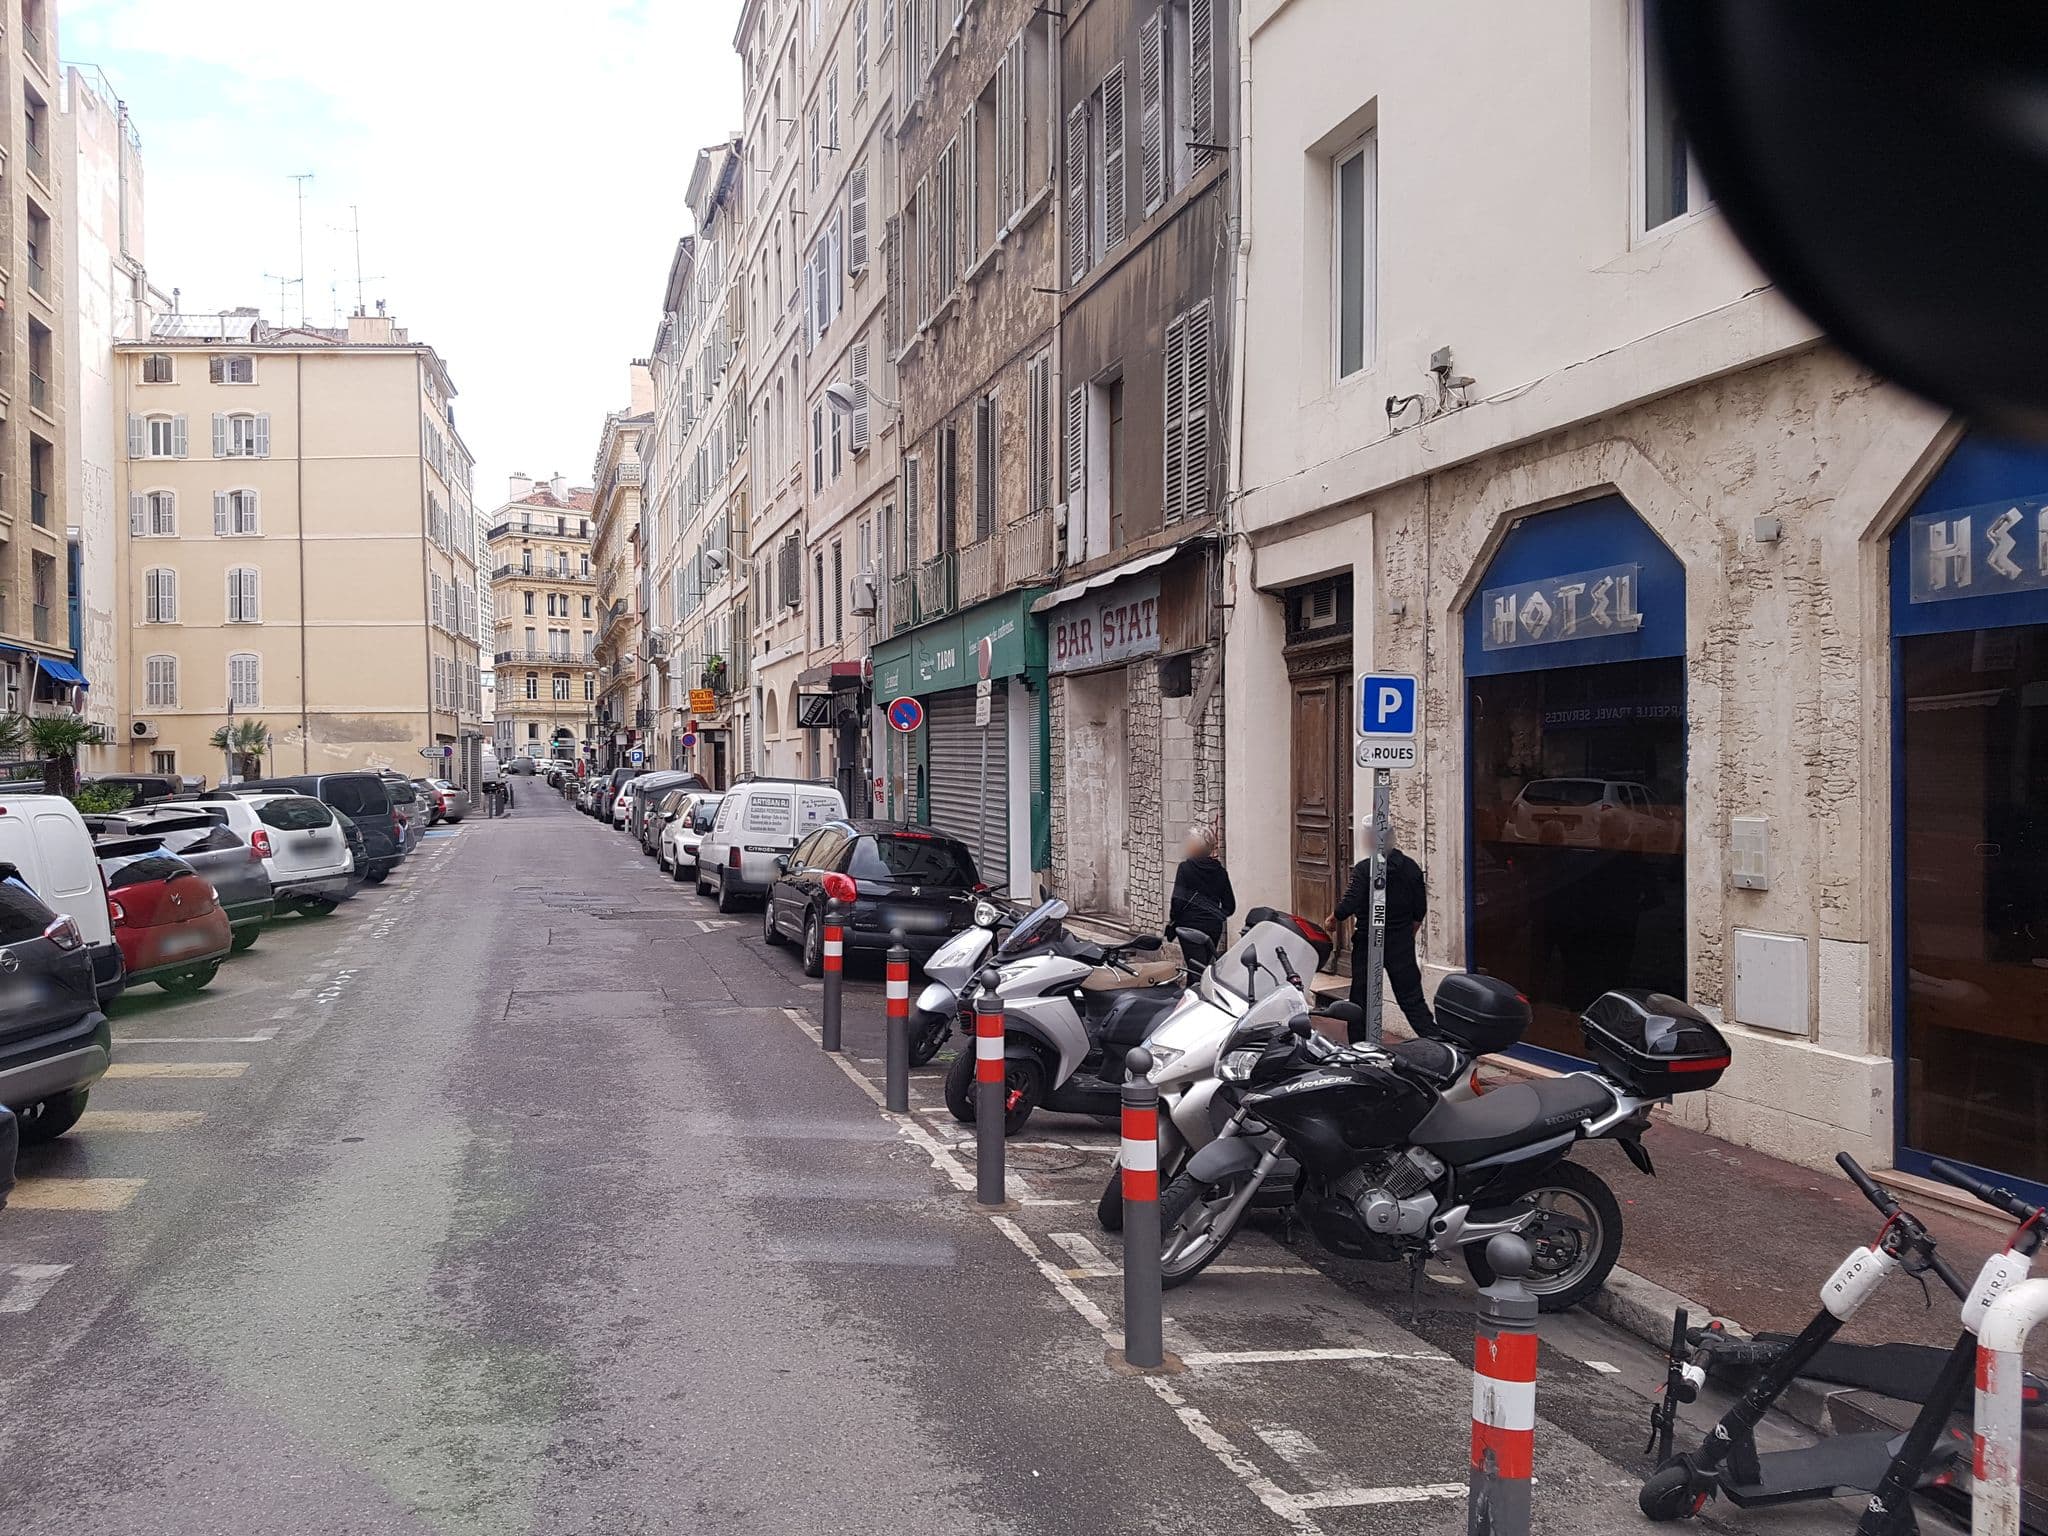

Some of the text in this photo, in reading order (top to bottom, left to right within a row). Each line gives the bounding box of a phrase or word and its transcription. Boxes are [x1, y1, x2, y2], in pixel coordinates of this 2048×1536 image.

[1929, 506, 2048, 591] HE
[1493, 574, 1644, 645] HOTEL
[1057, 618, 1093, 662] BAR
[1378, 687, 1403, 724] P
[1374, 747, 1414, 760] ROUES
[1374, 904, 1385, 926] BNE
[1285, 1076, 1352, 1093] VARADERO
[1544, 1107, 1595, 1126] HONDA
[1833, 1262, 1863, 1294] BIRD
[1981, 1268, 2008, 1308] BIRD
